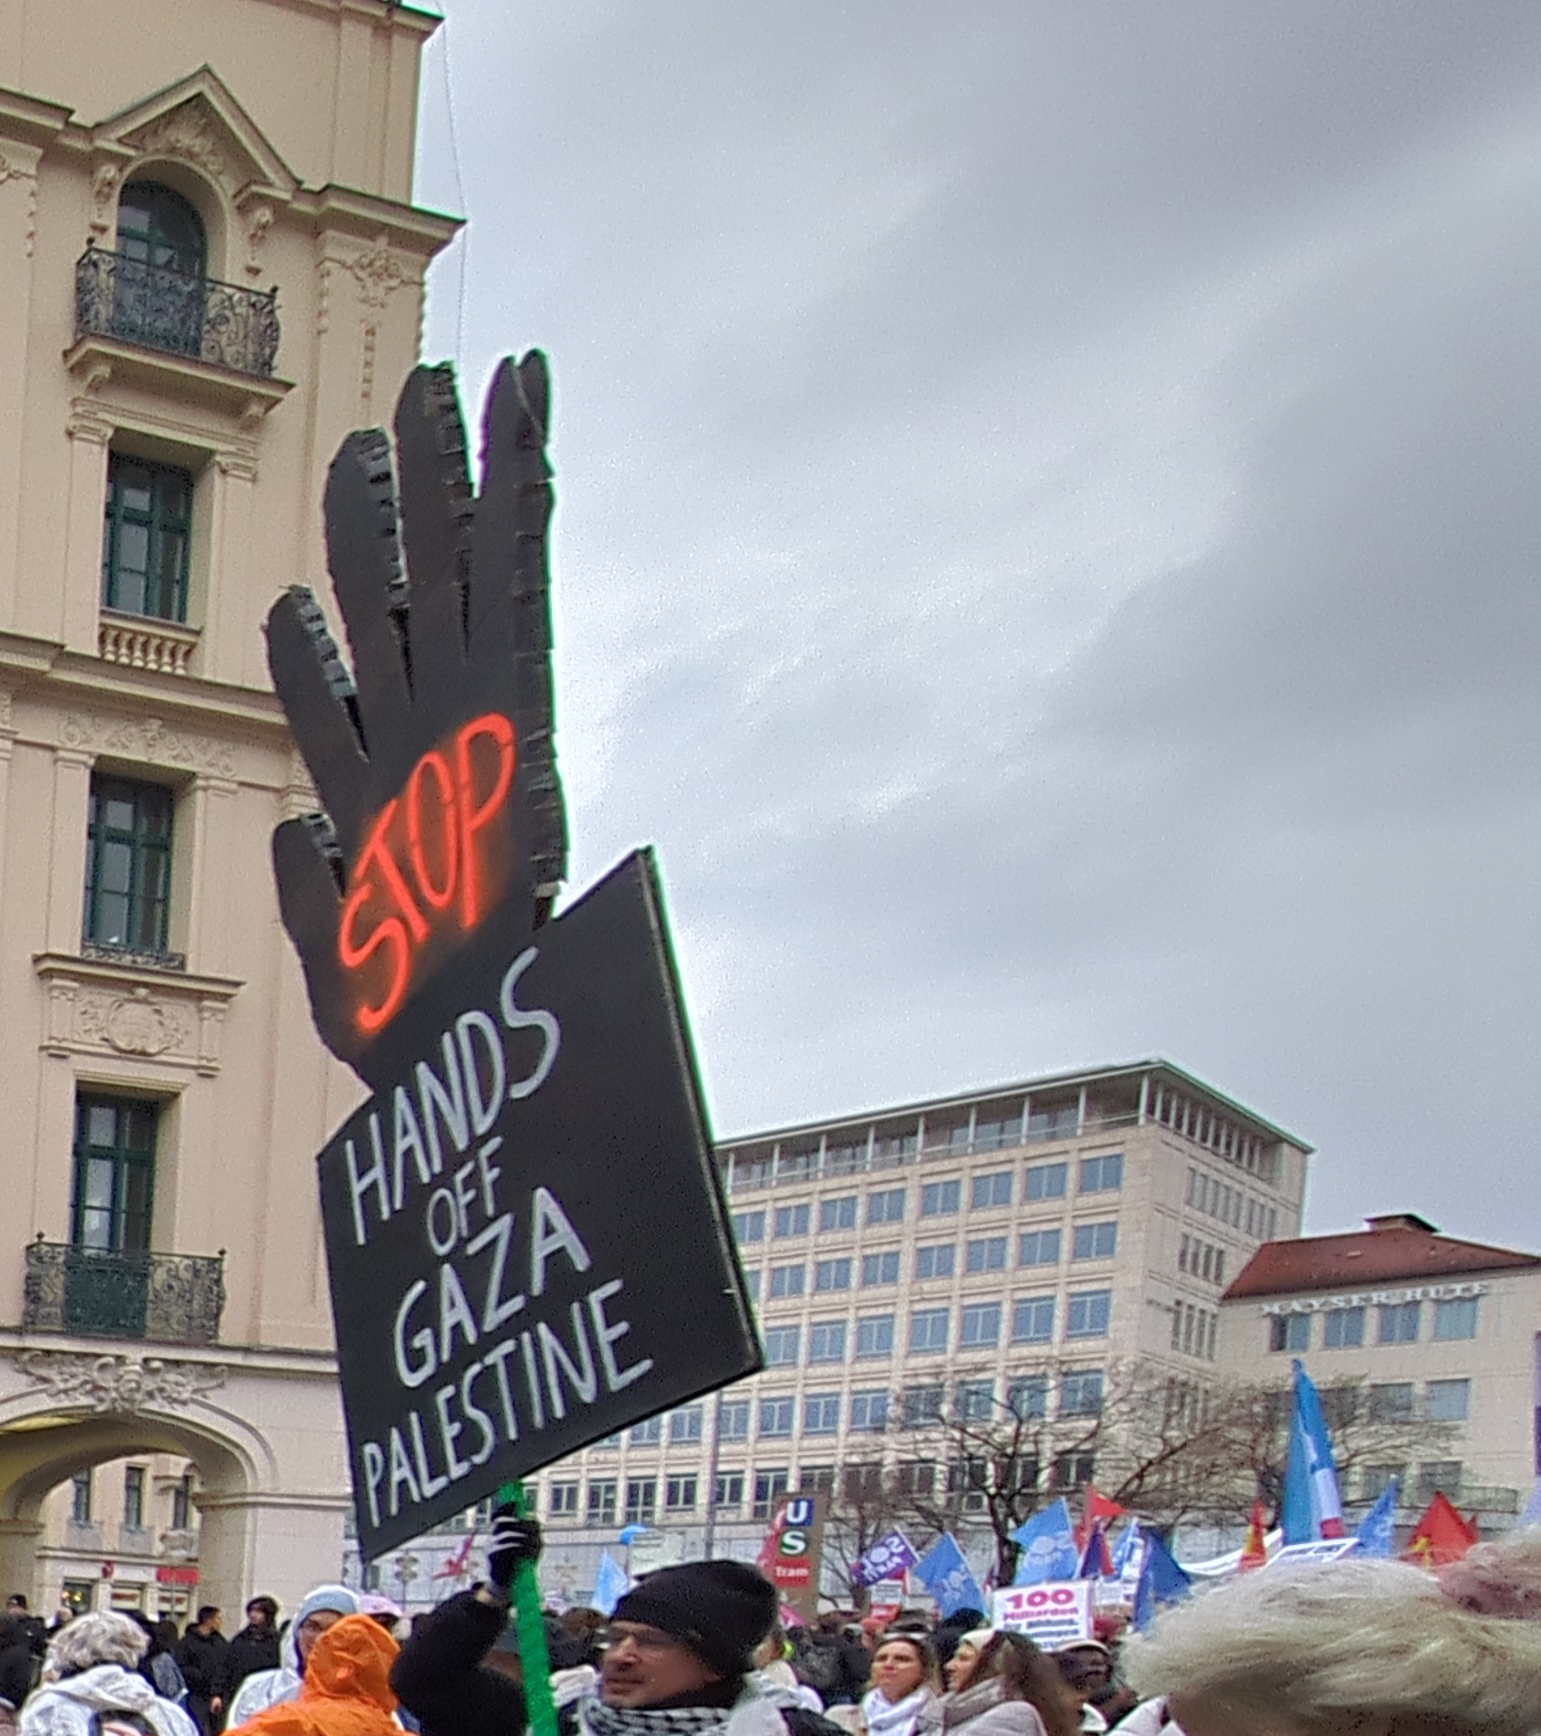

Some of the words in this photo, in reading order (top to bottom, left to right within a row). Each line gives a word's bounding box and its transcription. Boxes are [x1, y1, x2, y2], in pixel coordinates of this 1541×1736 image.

[337, 711, 515, 1034] STOP
[345, 946, 561, 1246] HANDS
[427, 1136, 502, 1257] OFF
[393, 1186, 591, 1389] GAZA
[360, 1279, 655, 1529] PALESTINE
[774, 1565, 810, 1578] Tram
[780, 1530, 807, 1555] S
[785, 1500, 809, 1524] U
[1005, 1588, 1075, 1610] 100
